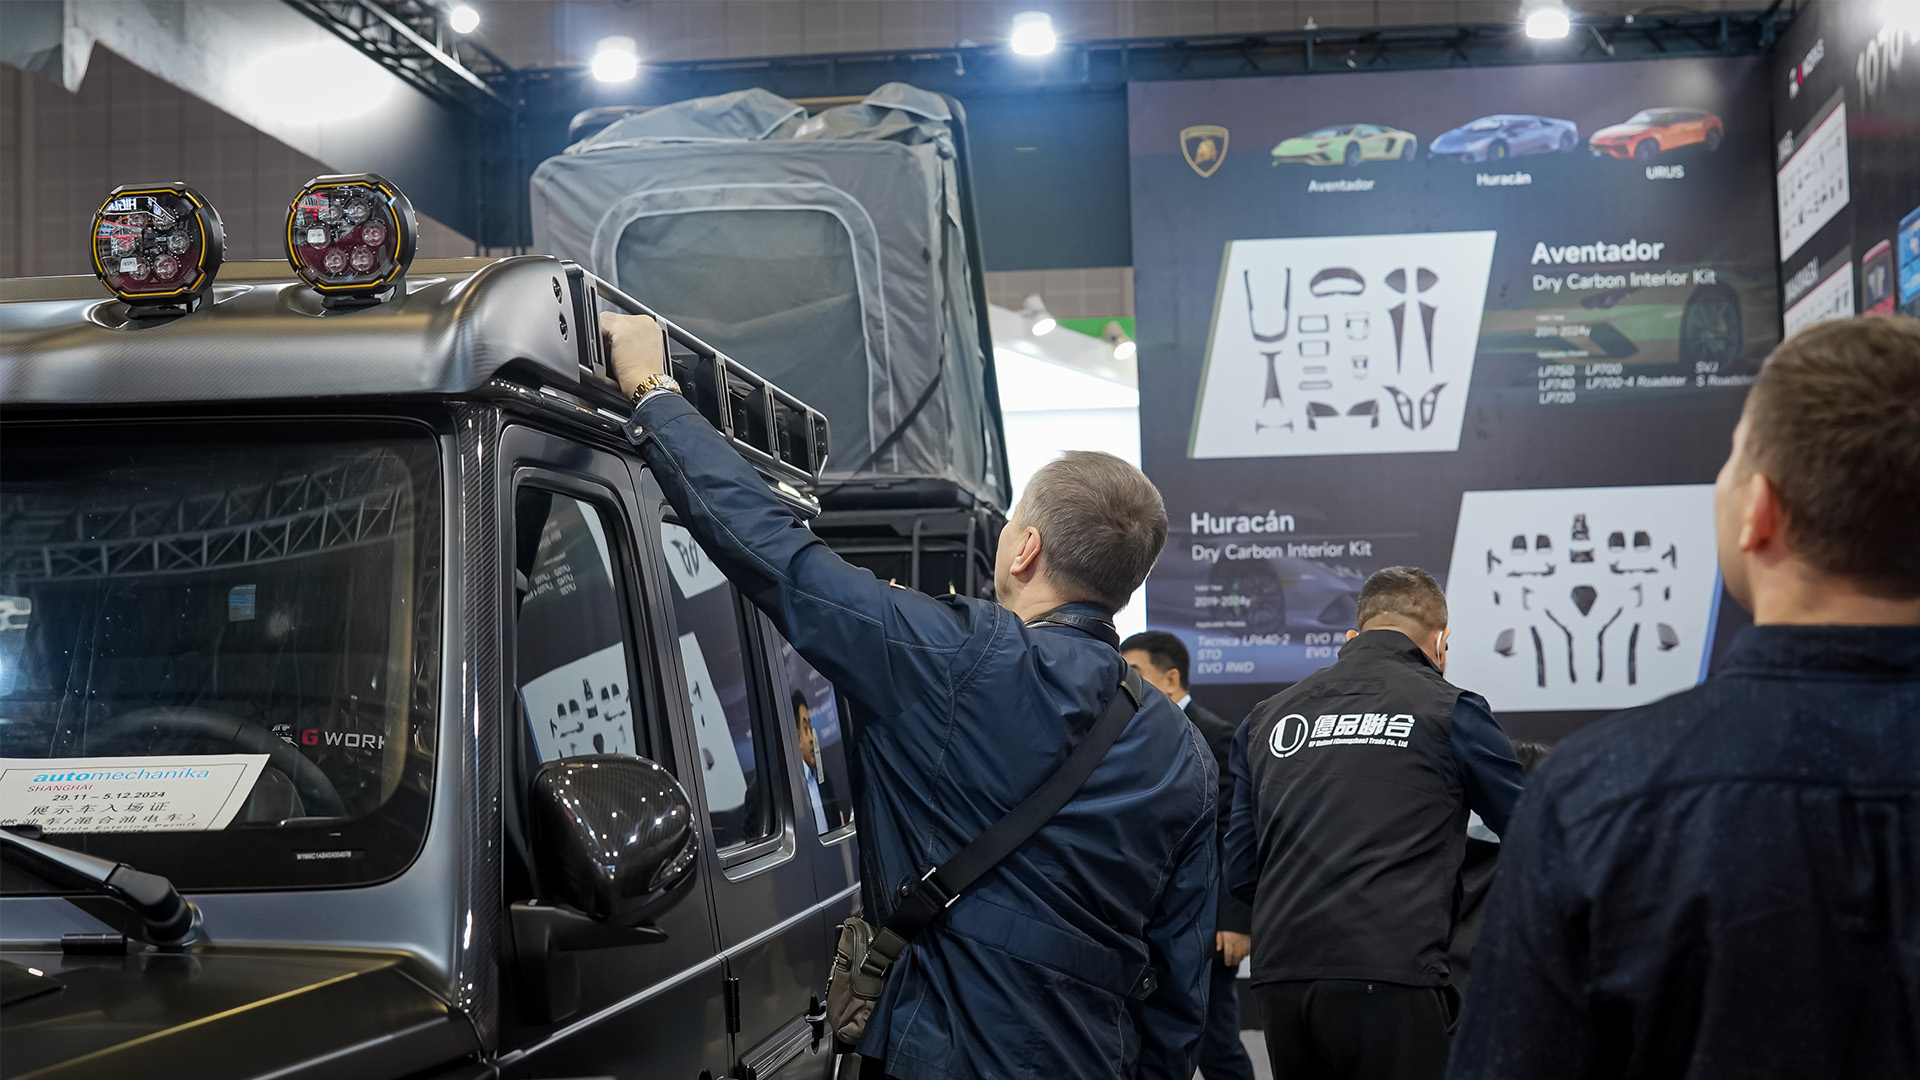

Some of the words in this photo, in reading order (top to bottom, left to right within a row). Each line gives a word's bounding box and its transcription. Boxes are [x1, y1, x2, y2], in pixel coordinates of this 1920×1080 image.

[1477, 171, 1531, 187] Huracán
[1646, 165, 1684, 181] URUS
[1308, 178, 1375, 193] Aventador
[1531, 238, 1665, 265] Aventador
[1533, 274, 1562, 294] Dry
[1567, 272, 1625, 290] Carbon
[1630, 270, 1688, 288] Interior
[1693, 268, 1716, 285] Kit
[1191, 509, 1295, 535] Huracán
[1192, 545, 1221, 564] Dry
[1225, 543, 1283, 561] Carbon
[1288, 541, 1344, 559] Interior
[1349, 540, 1372, 557] Kit
[1304, 633, 1331, 646] EVO
[1197, 648, 1223, 661] STO
[1305, 646, 1331, 659] EVO
[1197, 661, 1224, 674] EVO
[1225, 660, 1255, 673] RWD
[1310, 713, 1416, 738] 優品聯合
[302, 729, 319, 745] G
[33, 768, 210, 783] automechanika
[27, 784, 93, 793] SHANGHAI
[52, 793, 87, 802] 29.11
[103, 791, 166, 800] 5.12.2024
[27, 802, 170, 815] 展示车入场证
